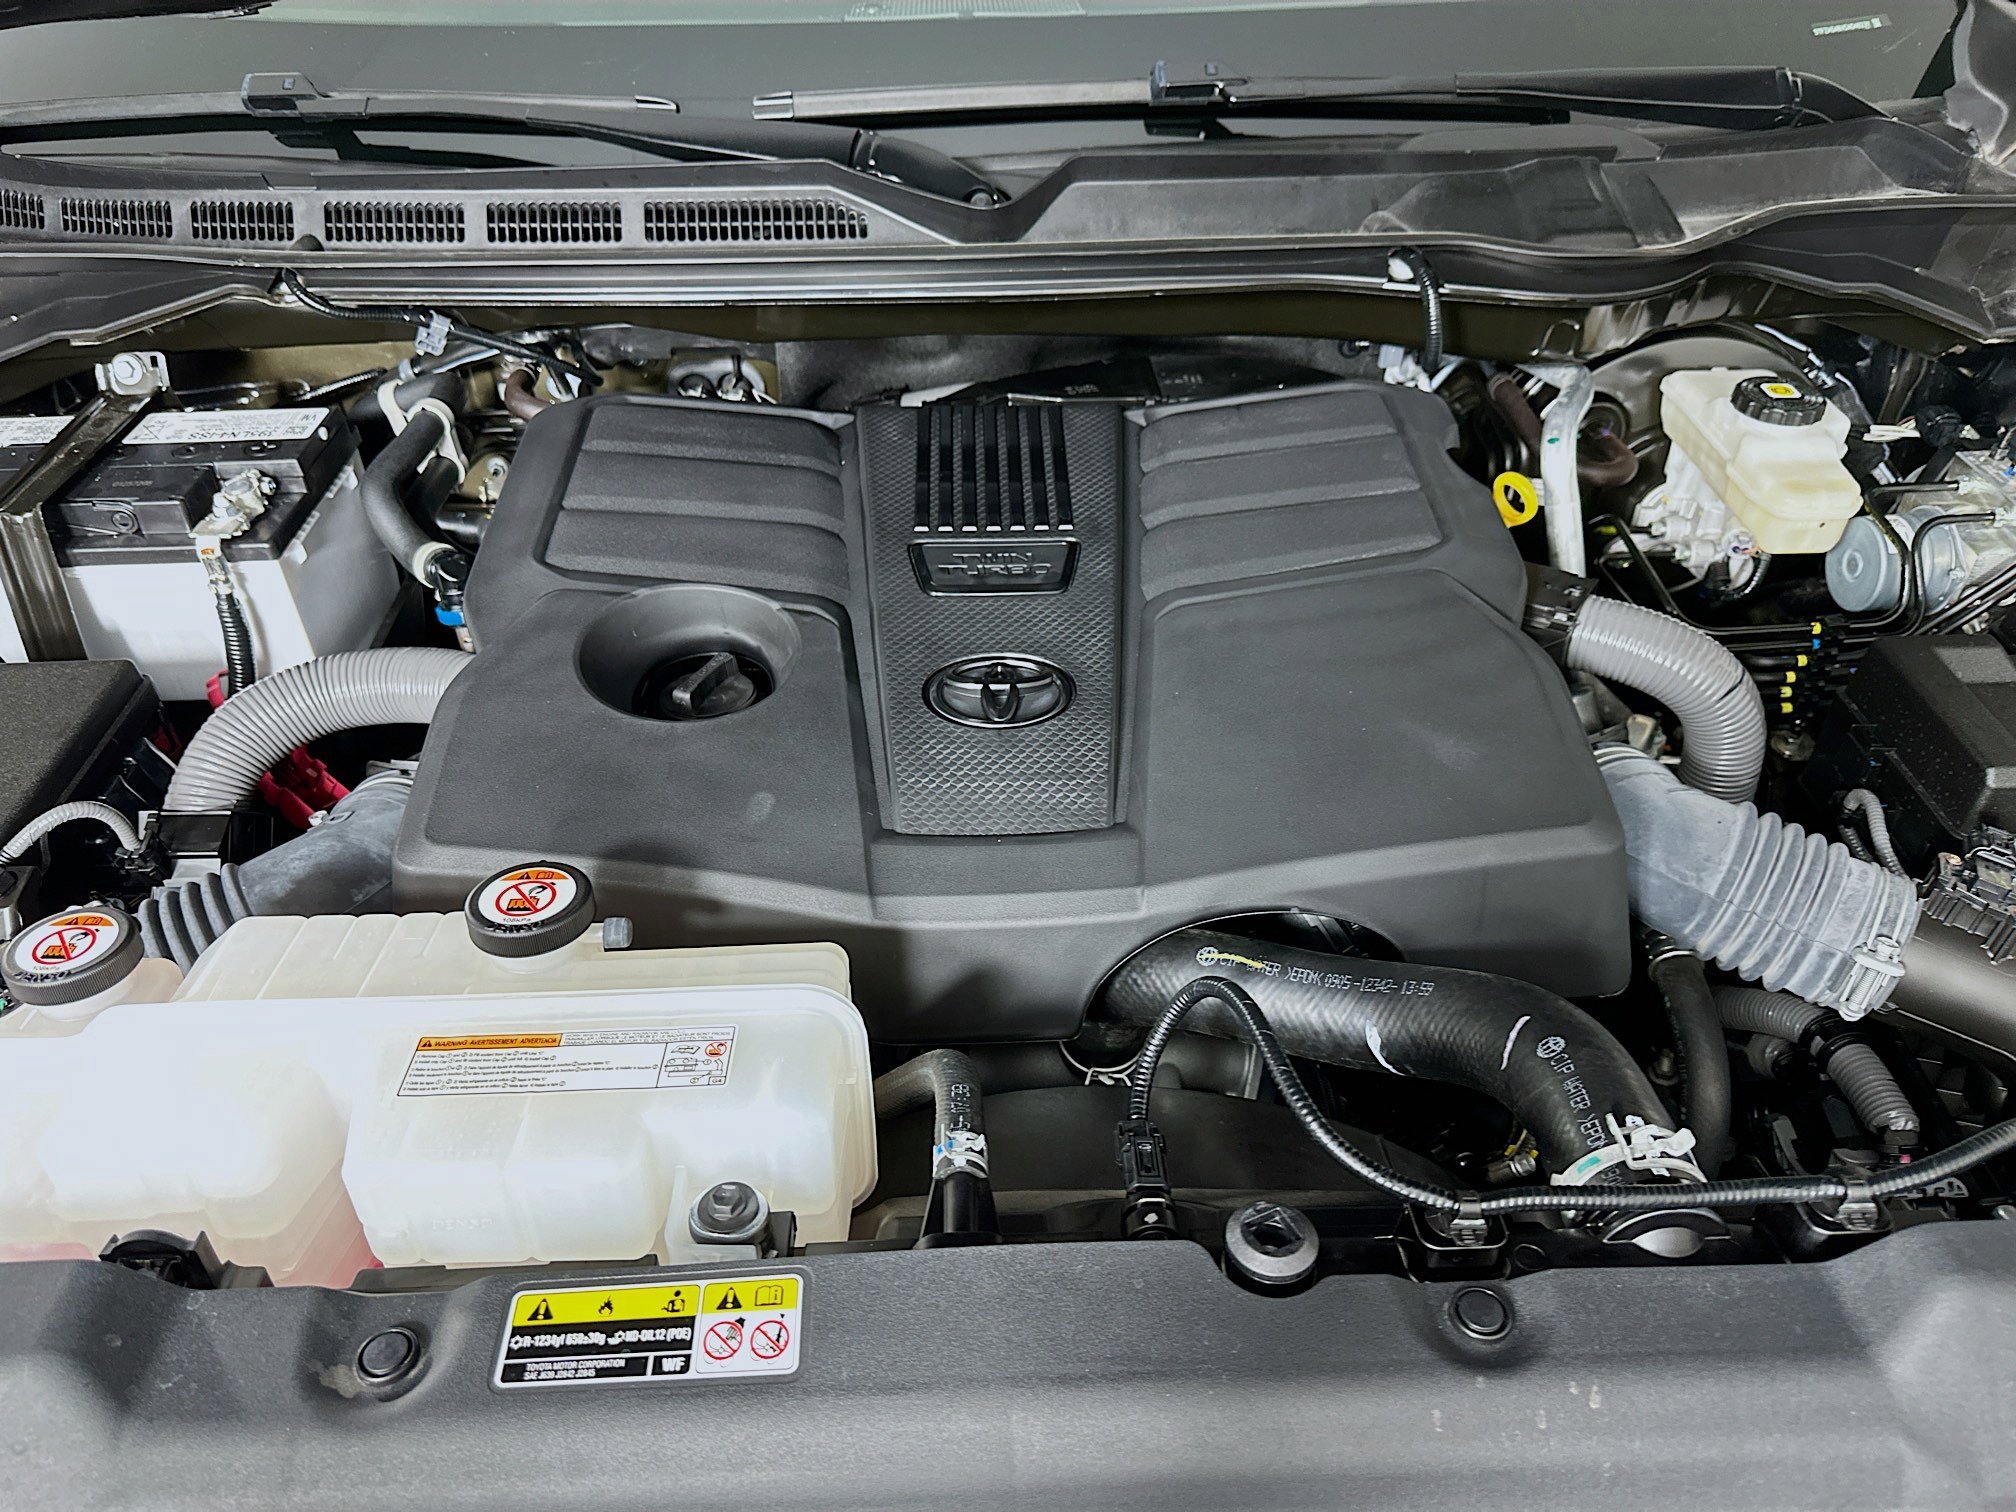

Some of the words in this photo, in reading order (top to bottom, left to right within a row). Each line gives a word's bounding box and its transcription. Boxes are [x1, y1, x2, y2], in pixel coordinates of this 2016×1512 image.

[470, 1038, 518, 1046] AVERTISSEMENT
[526, 1362, 552, 1372] TOYOTA
[553, 1361, 578, 1370] MOTOR
[578, 1359, 626, 1369] CORPORATION
[661, 1357, 686, 1372] WF
[523, 1371, 538, 1380] SAE
